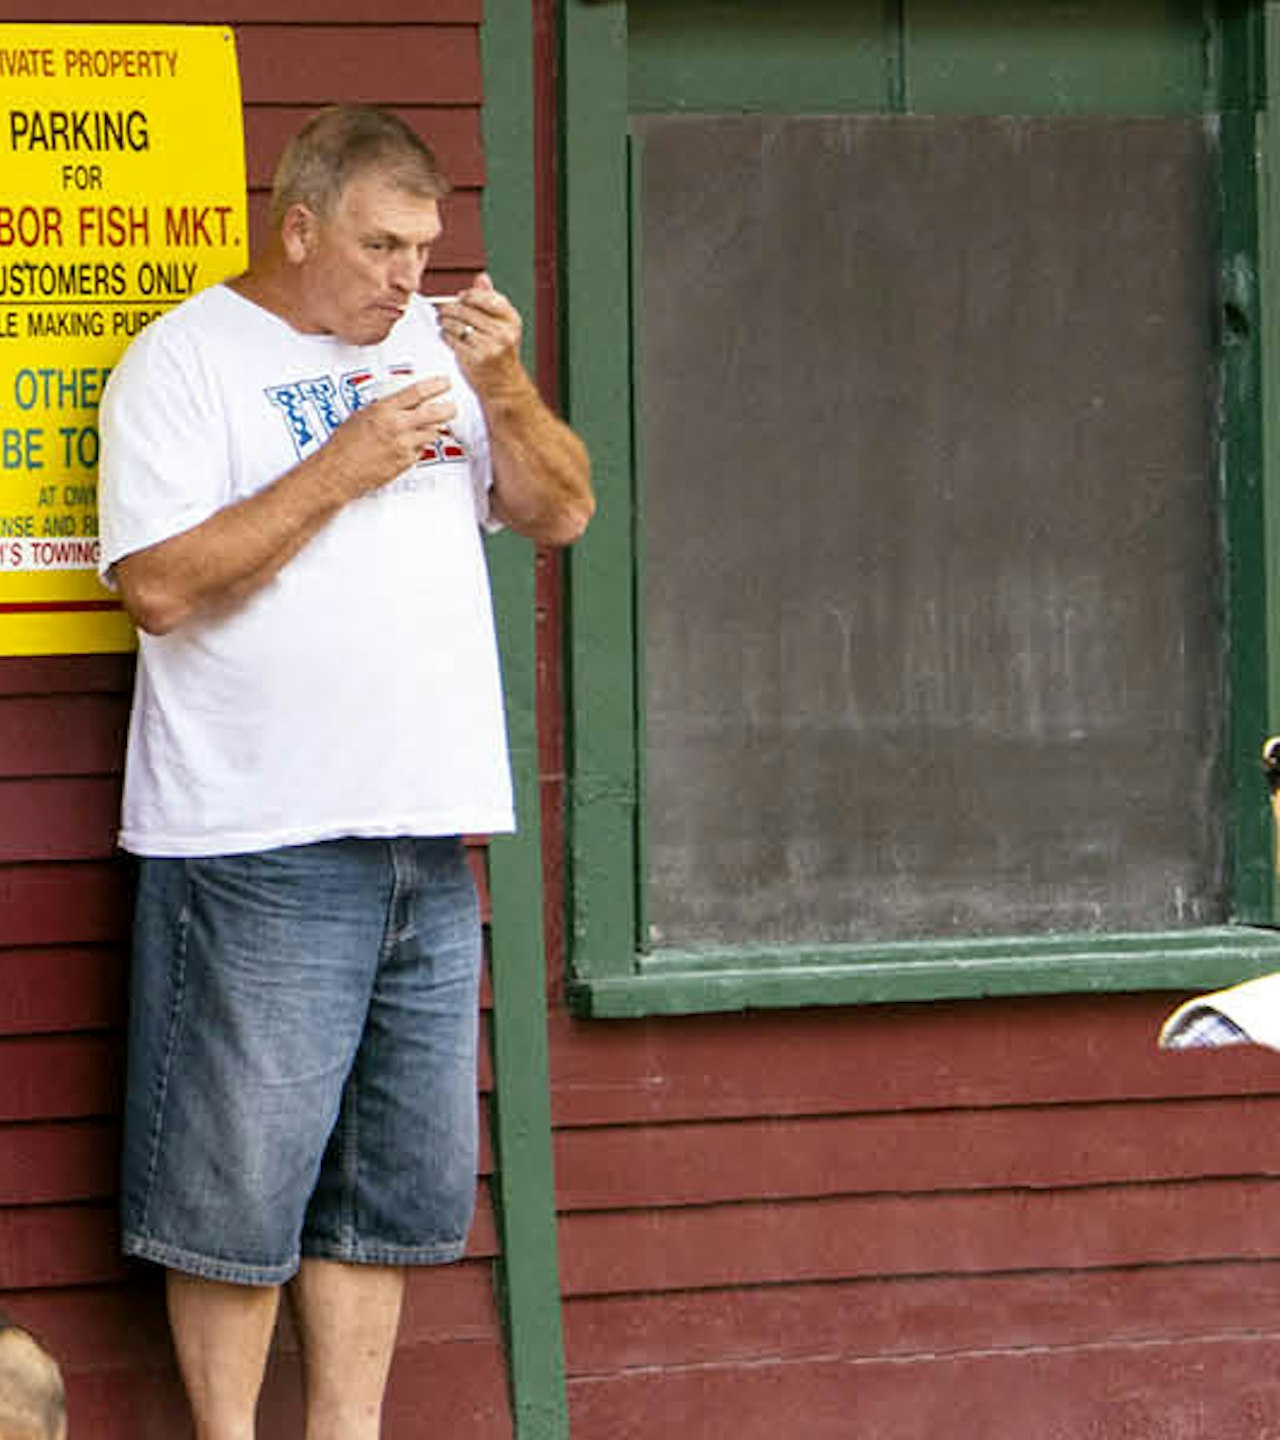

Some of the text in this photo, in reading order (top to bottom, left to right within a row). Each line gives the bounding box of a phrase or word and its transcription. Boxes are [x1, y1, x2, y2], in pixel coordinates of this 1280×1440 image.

[66, 49, 178, 78] PROPERTY
[10, 111, 149, 151] PARKING
[62, 165, 103, 190] FOR
[79, 207, 150, 247] FISH
[166, 206, 241, 247] MKT.
[138, 263, 197, 296] ONLY
[27, 312, 104, 337] MAKING
[2, 426, 101, 469] BE TO
[38, 486, 99, 507] AT OWN
[43, 516, 75, 537] AND
[31, 542, 101, 565] TOWING
